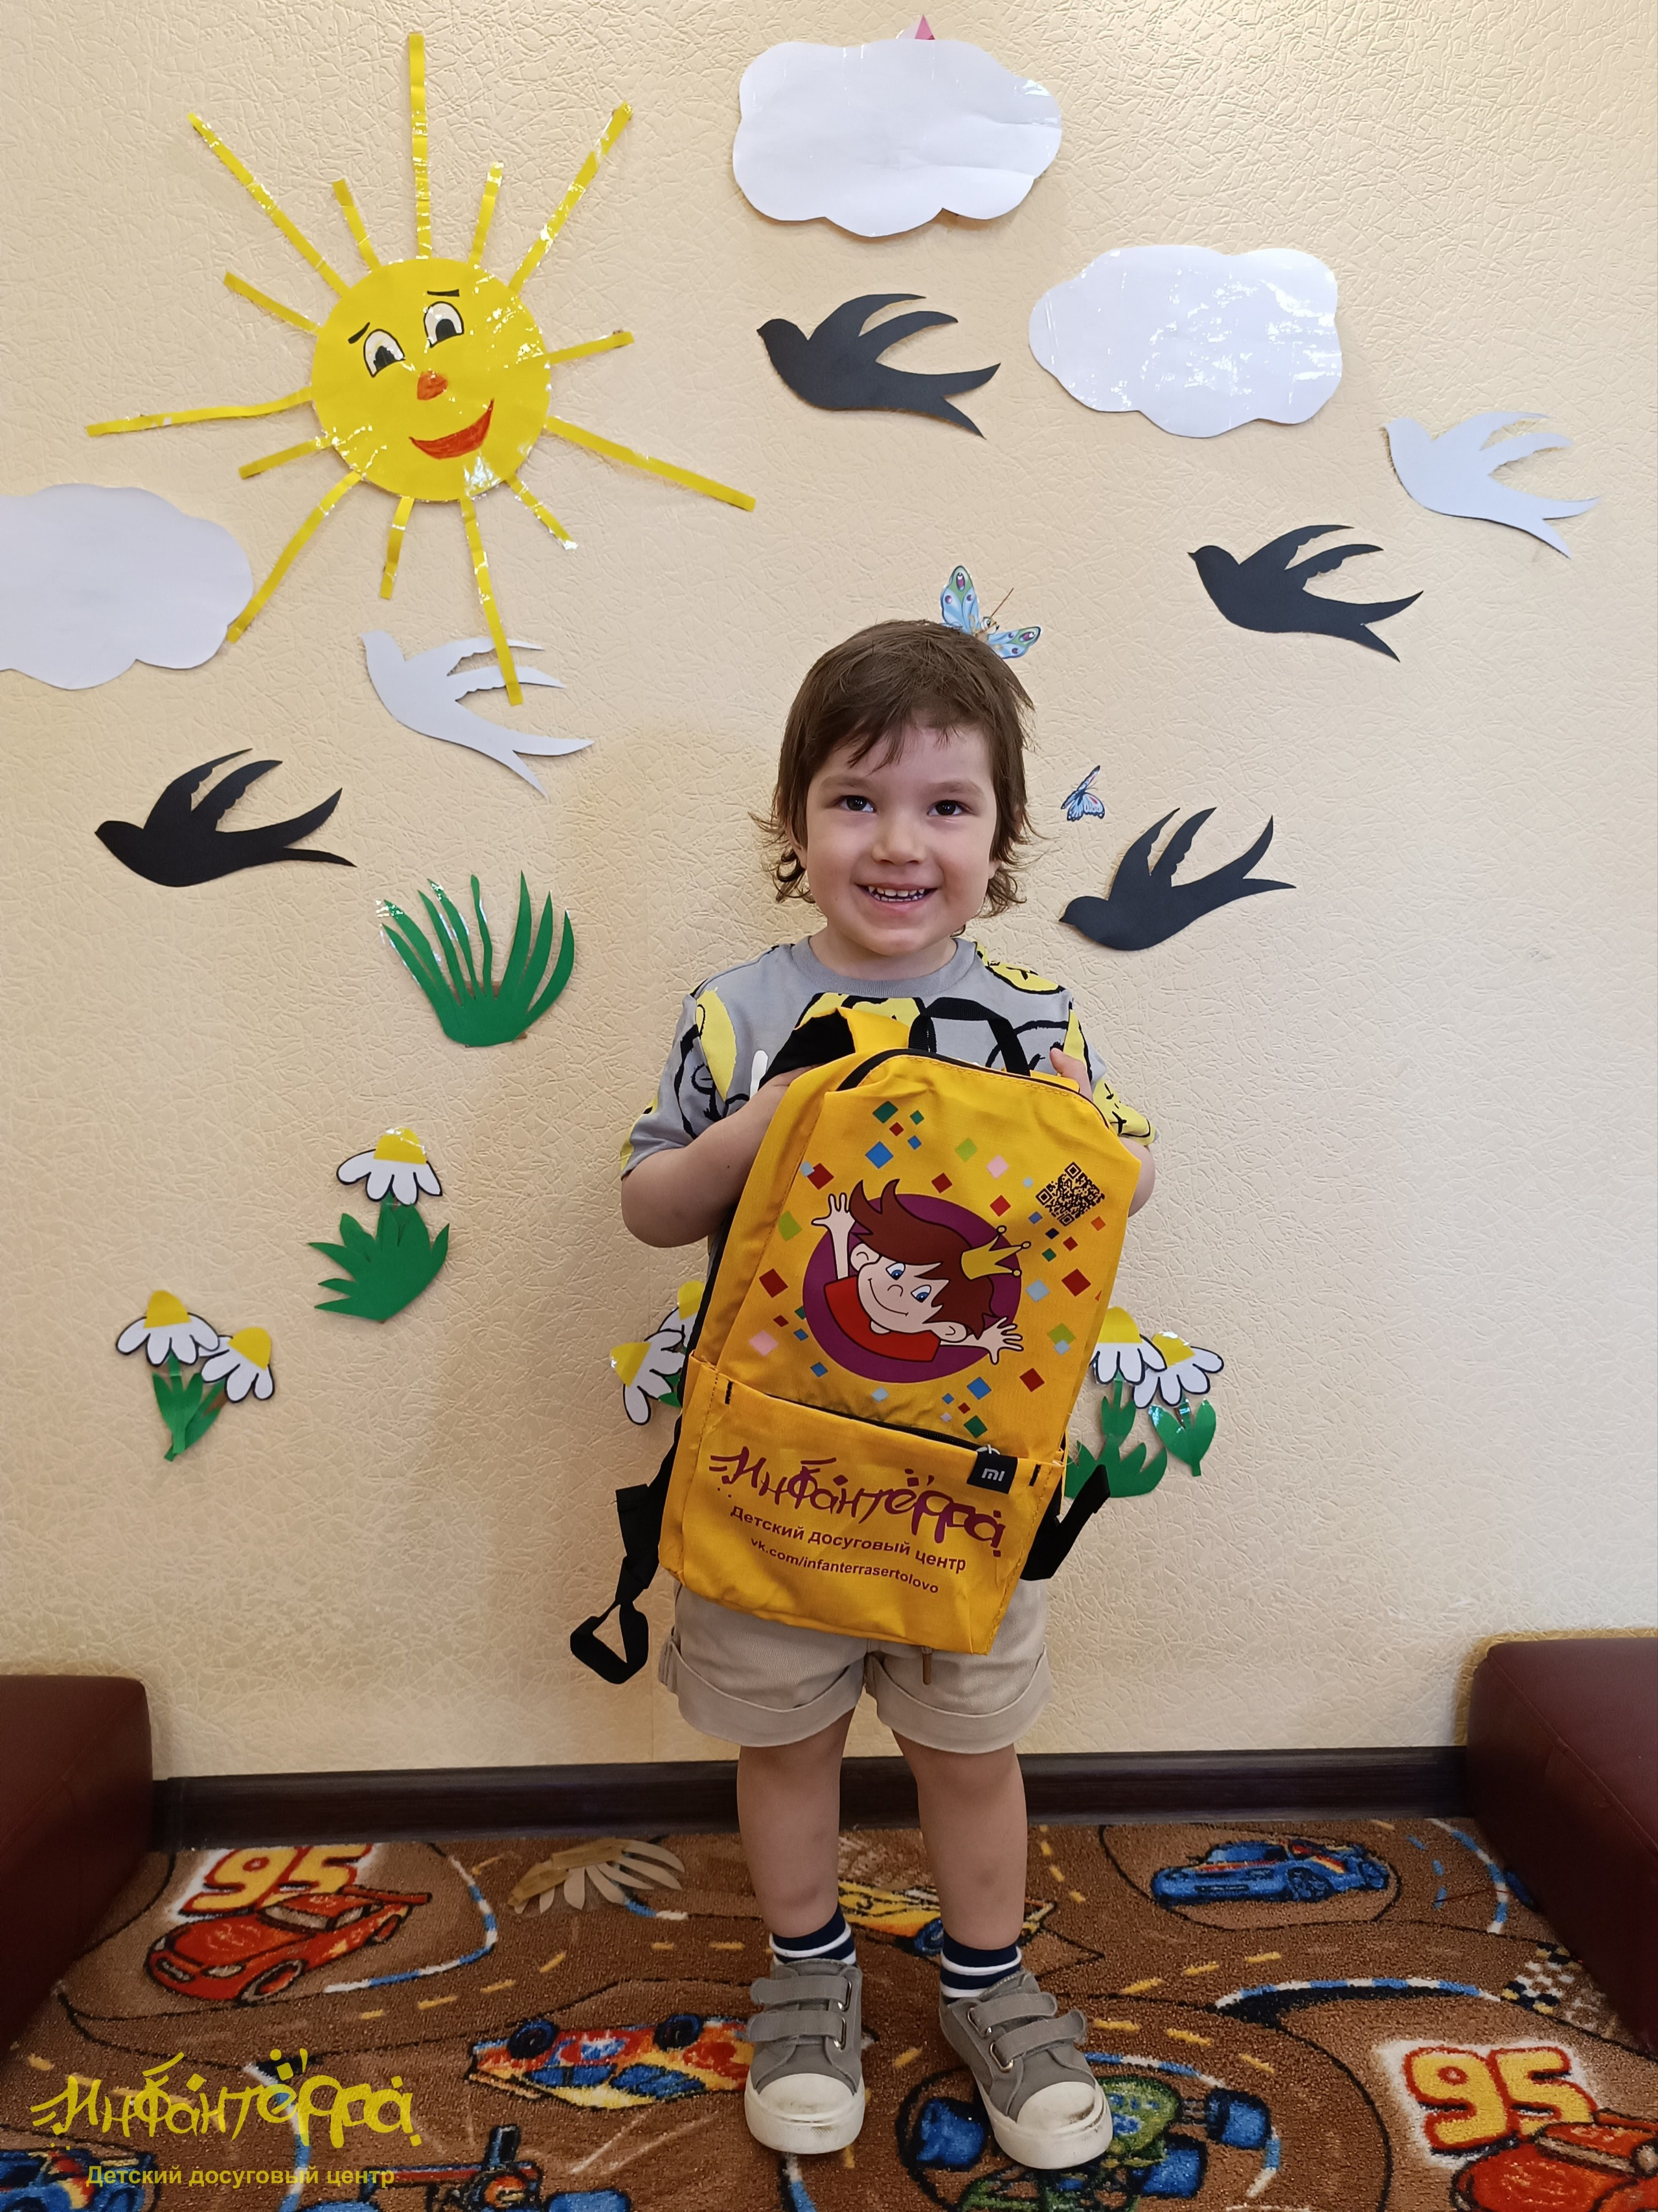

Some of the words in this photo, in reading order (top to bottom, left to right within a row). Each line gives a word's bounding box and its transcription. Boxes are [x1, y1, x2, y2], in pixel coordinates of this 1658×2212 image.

[730, 1506, 804, 1540] Детский
[808, 1531, 911, 1555] досуговый
[915, 1550, 966, 1574] центр
[751, 1537, 939, 1593] vk.com/infanterrasertolovo
[181, 1843, 372, 1912] 95
[1402, 2045, 1598, 2150] 95
